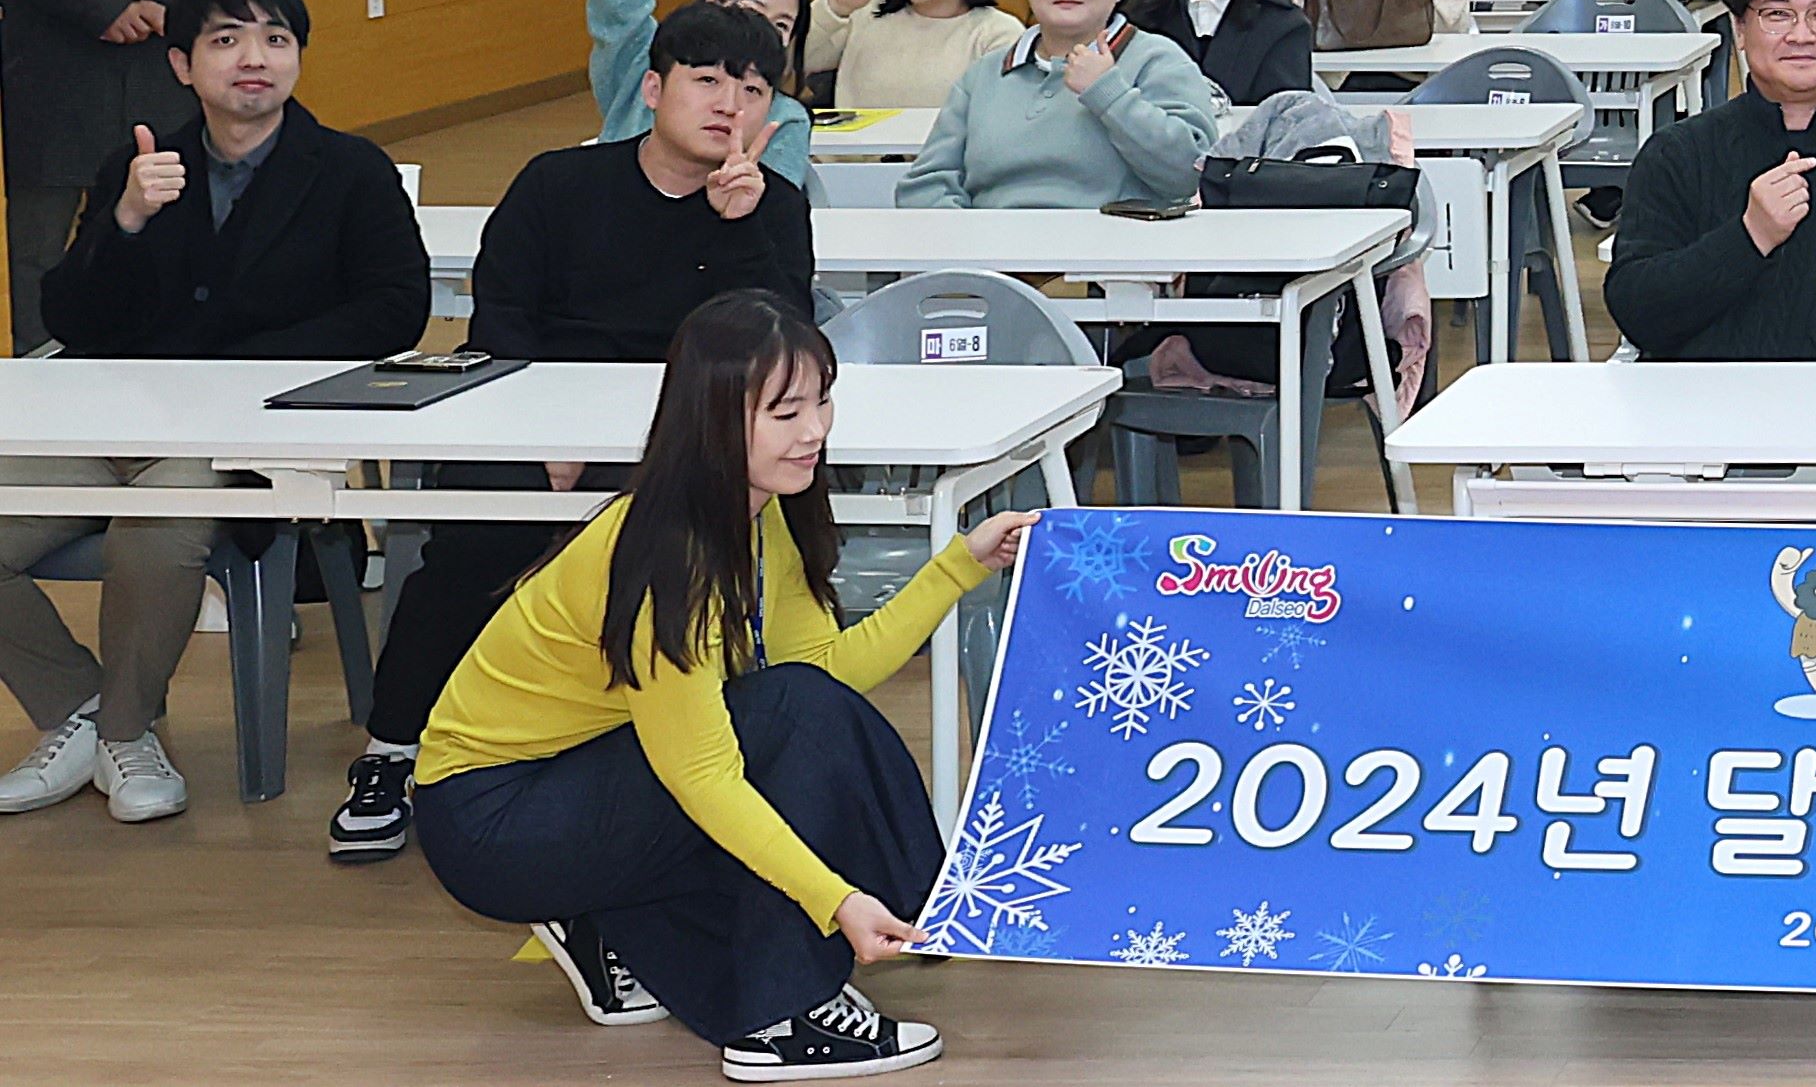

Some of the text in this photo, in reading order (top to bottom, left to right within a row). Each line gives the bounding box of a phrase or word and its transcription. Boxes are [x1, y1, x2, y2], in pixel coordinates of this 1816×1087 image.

[1156, 534, 1341, 624] Smiling
[1246, 598, 1306, 617] Dalseo
[1129, 741, 1660, 872] 2024년
